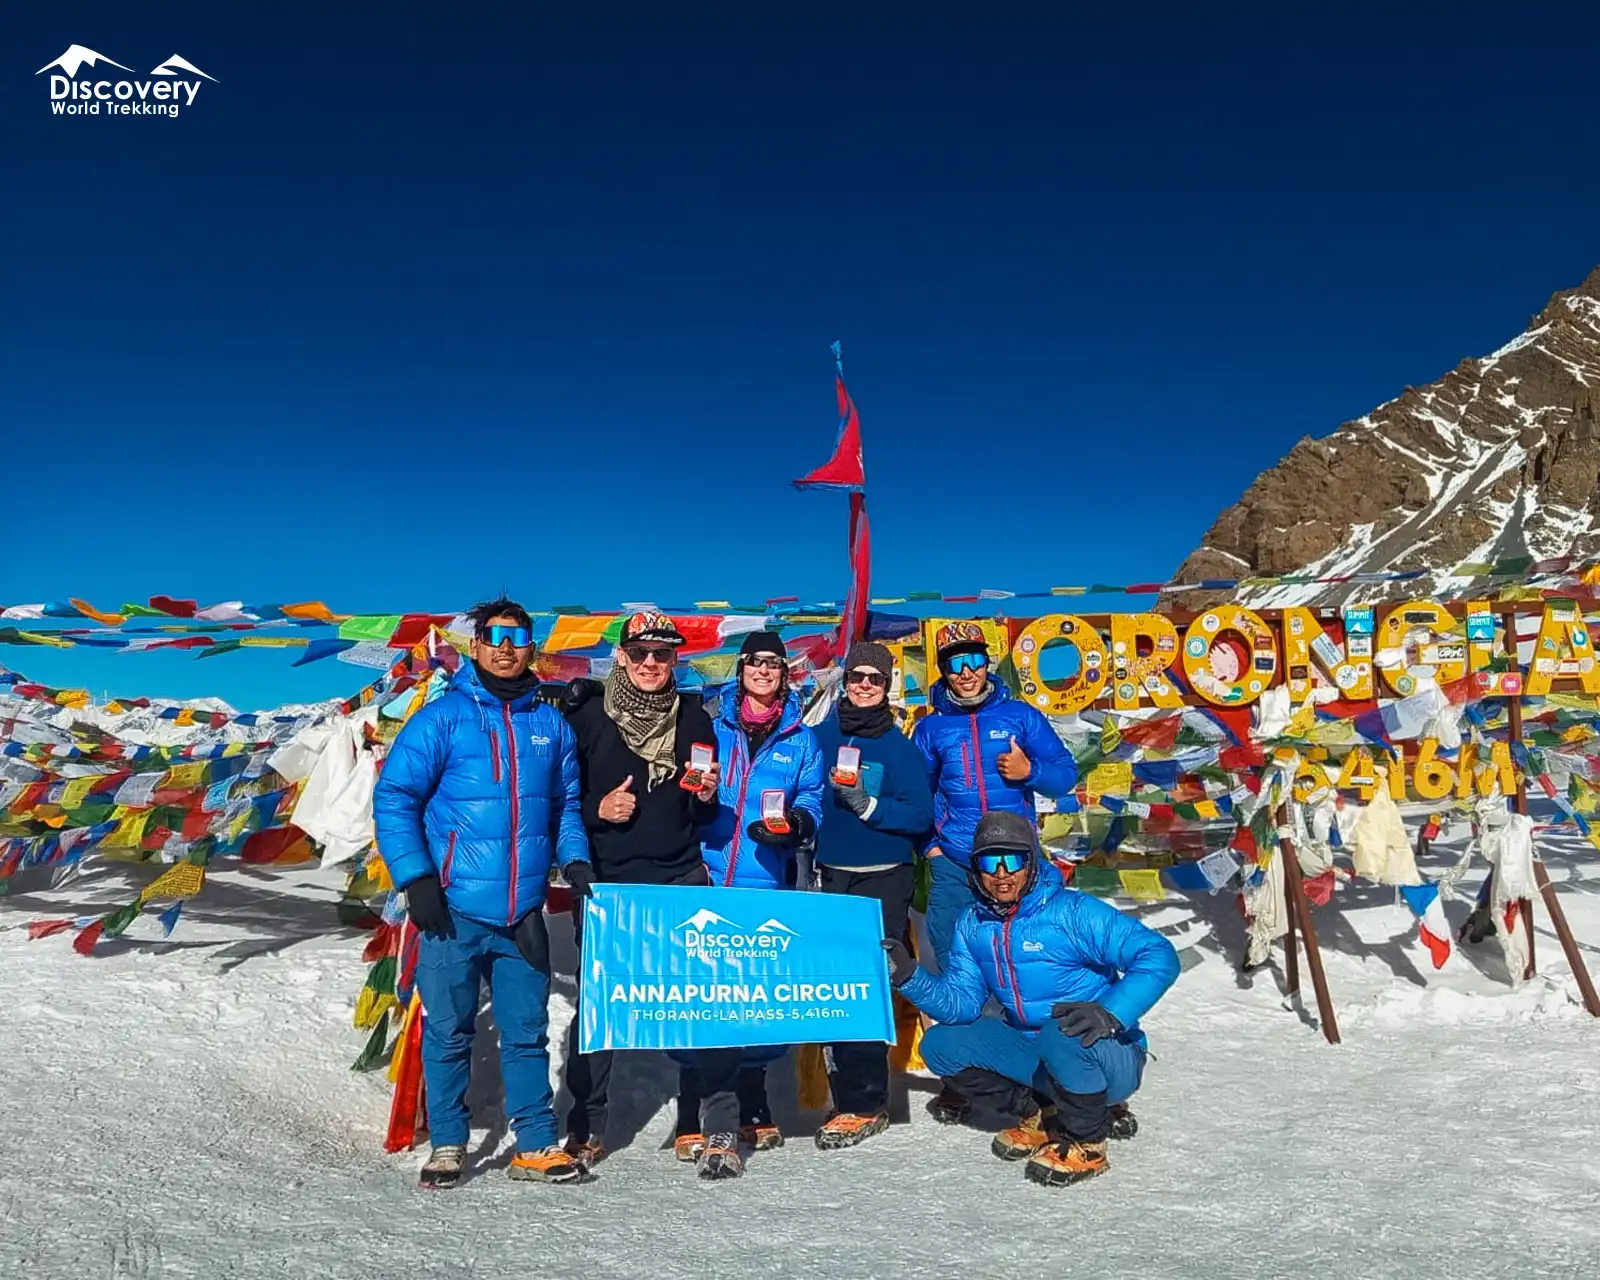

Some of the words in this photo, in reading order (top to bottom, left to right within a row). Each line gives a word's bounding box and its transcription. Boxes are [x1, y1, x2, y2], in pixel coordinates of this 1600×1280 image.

[685, 929, 792, 952] Discovery
[686, 948, 721, 959] World
[724, 947, 778, 960] Trekking
[610, 984, 769, 1003] ANNAPURNA
[774, 983, 870, 1002] CIRCUIT
[633, 1008, 740, 1021] THORANG-LA
